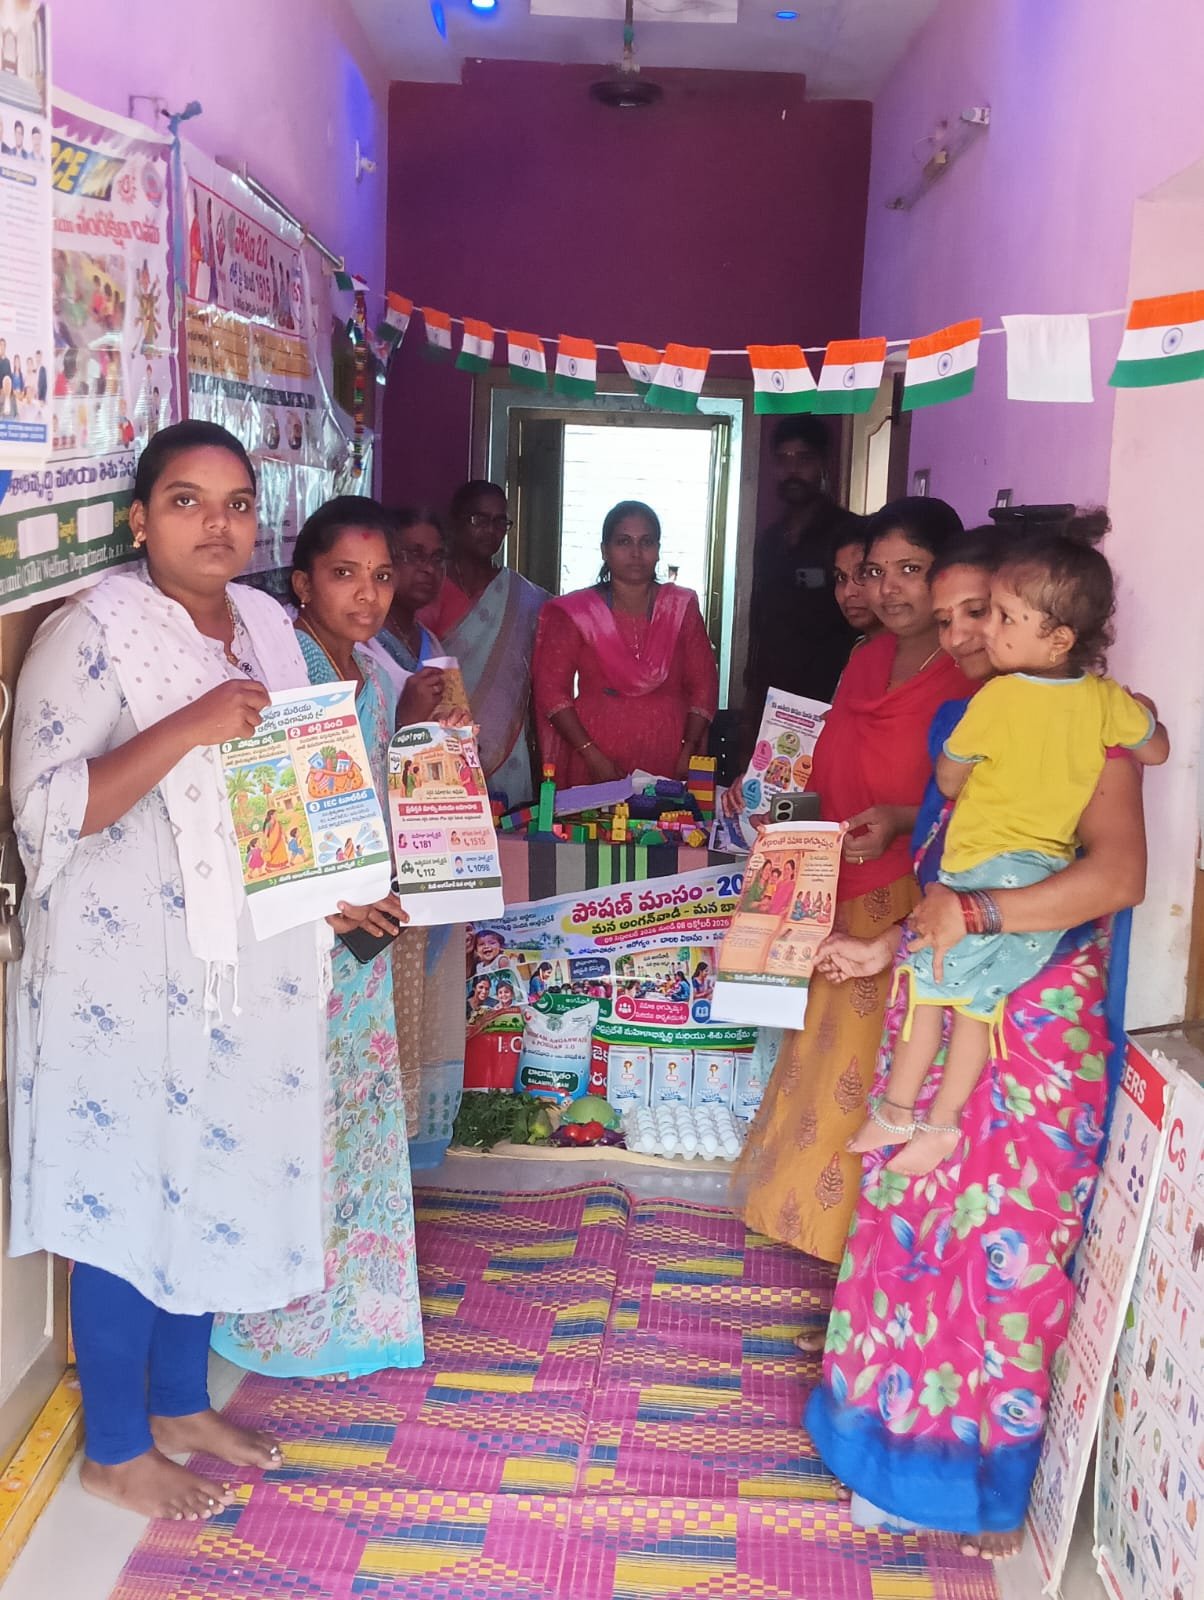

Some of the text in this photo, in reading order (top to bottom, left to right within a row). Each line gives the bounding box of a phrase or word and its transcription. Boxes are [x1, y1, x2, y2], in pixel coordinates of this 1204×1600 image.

[283, 703, 312, 716] మరియు
[323, 799, 337, 809] IEC
[419, 840, 432, 848] 181
[470, 837, 486, 846] 1515
[423, 868, 437, 876] 112
[473, 863, 490, 872] 1098
[571, 892, 633, 924] పోషణ్
[591, 922, 616, 935] మన
[693, 902, 717, 915] మన
[720, 900, 735, 912] బా
[595, 1024, 623, 1036] ంధ్రప్రదేశ్
[675, 1031, 706, 1040] మరియు
[1124, 1113, 1133, 1140] 3
[1159, 1178, 1169, 1204] D
[1117, 1216, 1127, 1243] 8
[1185, 1207, 1194, 1233] E
[1148, 1248, 1157, 1275] H
[1073, 1384, 1087, 1420] 16
[1130, 1388, 1138, 1410] P
[1188, 1394, 1198, 1426] N
[1145, 1498, 1153, 1527] U
